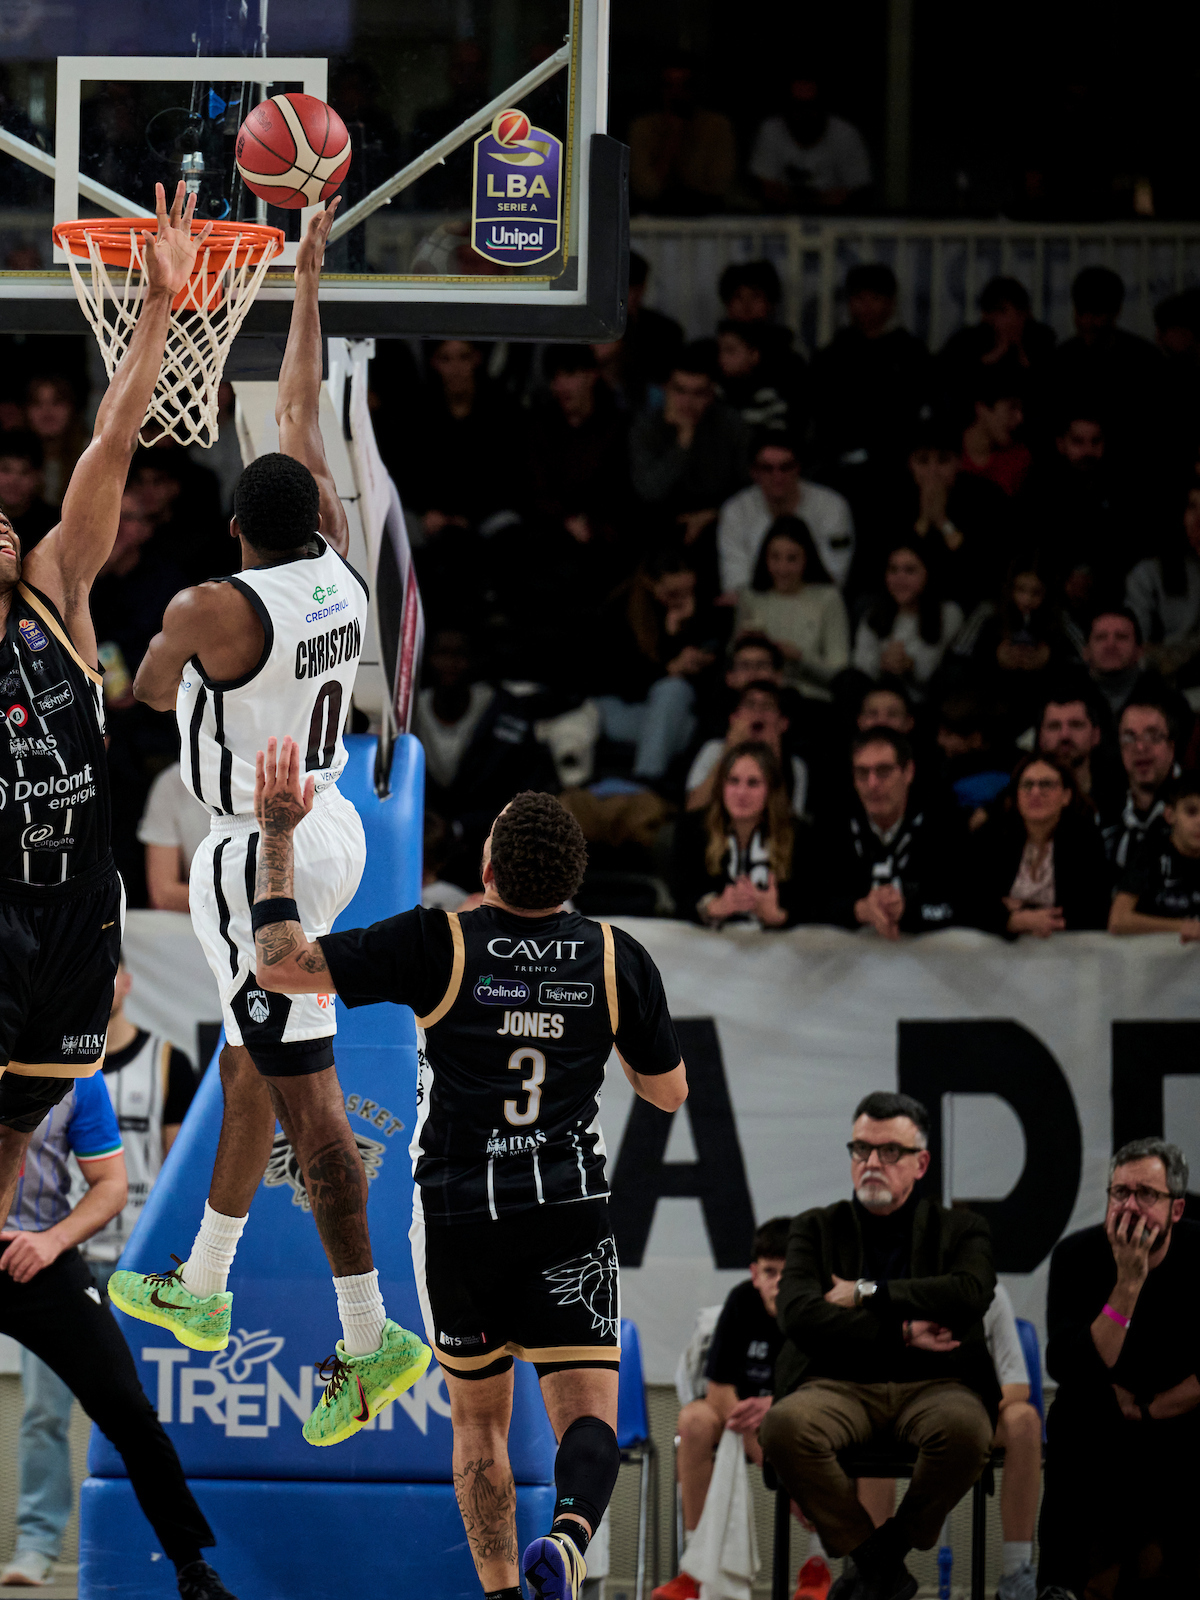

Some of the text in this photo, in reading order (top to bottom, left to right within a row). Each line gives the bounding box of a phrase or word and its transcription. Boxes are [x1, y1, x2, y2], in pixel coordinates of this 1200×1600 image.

[486, 173, 551, 199] LBA
[497, 202, 538, 212] SERIE A
[491, 225, 543, 251] Unipol
[326, 584, 339, 597] BC
[294, 616, 361, 680] CHRISTON
[305, 679, 343, 773] 0
[14, 763, 94, 802] Dolomit
[34, 837, 75, 849] corpoate
[486, 937, 585, 961] CAVIT
[514, 965, 557, 973] TRENTO
[246, 990, 268, 999] APU
[476, 984, 527, 998] Melinda
[545, 988, 589, 1002] TRENTINO
[496, 1010, 565, 1039] JONES
[503, 1046, 547, 1127] 3
[345, 1093, 405, 1137] SKET
[509, 1131, 548, 1151] ITAS
[141, 1346, 452, 1438] TRENN
